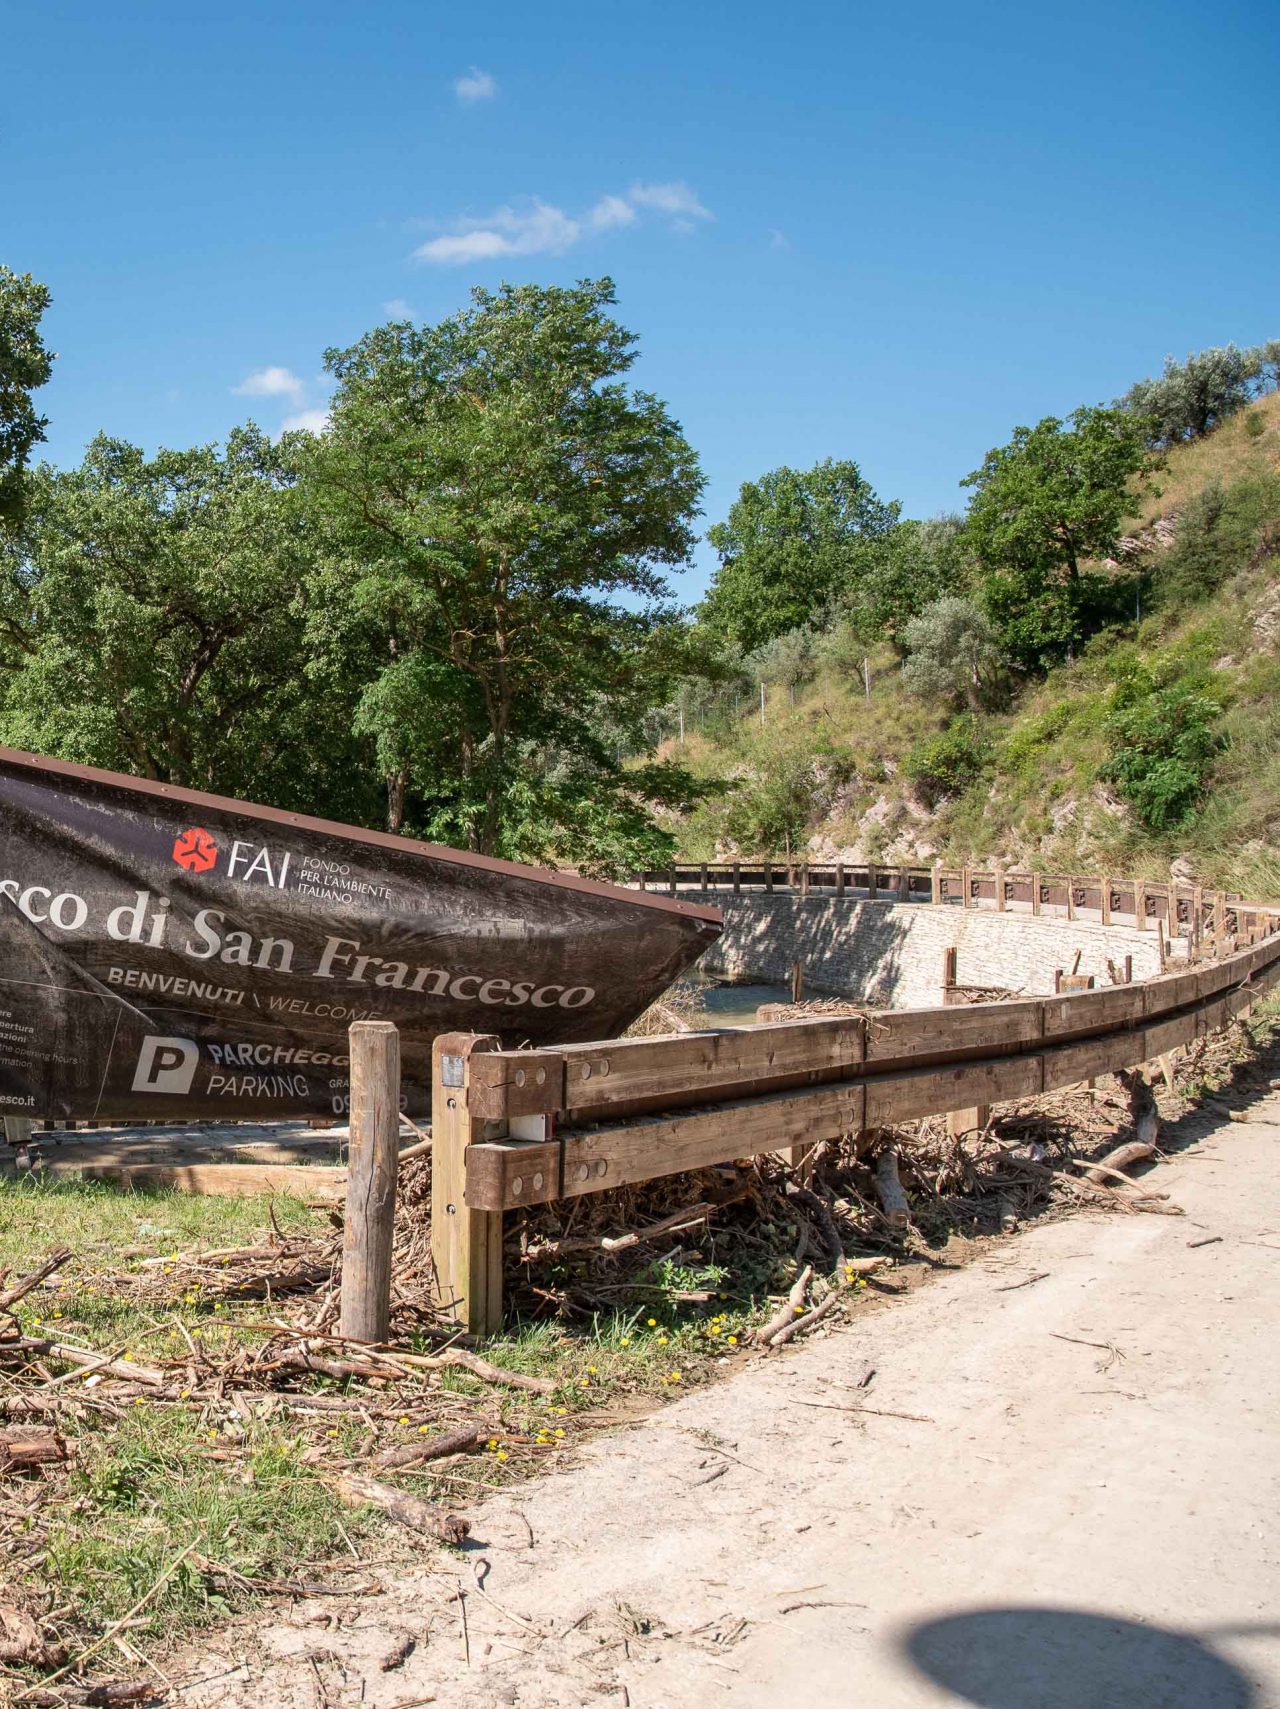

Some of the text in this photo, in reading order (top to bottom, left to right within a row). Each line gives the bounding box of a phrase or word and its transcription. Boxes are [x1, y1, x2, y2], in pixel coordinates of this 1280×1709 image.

[227, 840, 291, 889] FAI
[302, 856, 351, 876] FONDO
[297, 884, 353, 904] ITALIANO
[300, 869, 392, 900] PER L'AMBIENTE
[106, 890, 171, 949] di
[185, 908, 295, 974] San
[312, 935, 596, 1009] Francesco
[107, 966, 246, 1006] BENVENUTI
[14, 1047, 51, 1063] opening
[52, 1052, 79, 1066] hours
[147, 1045, 186, 1083] P
[206, 1043, 350, 1067] PARCHEGG
[206, 1074, 310, 1097] PARKING
